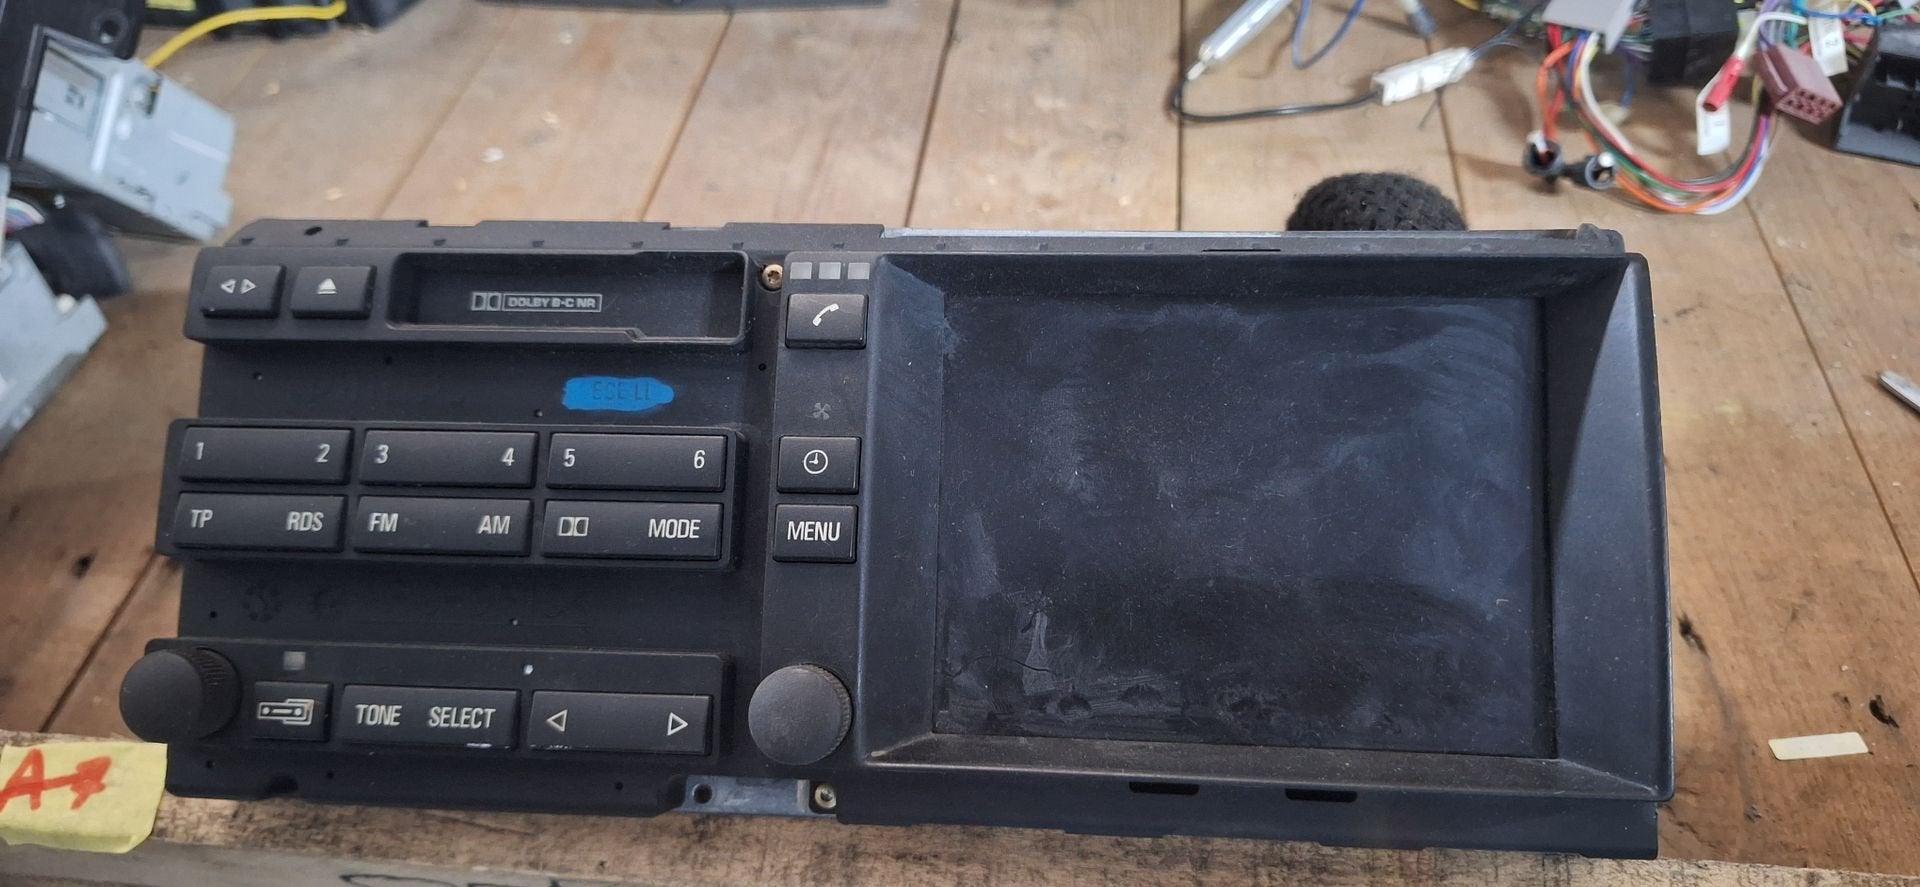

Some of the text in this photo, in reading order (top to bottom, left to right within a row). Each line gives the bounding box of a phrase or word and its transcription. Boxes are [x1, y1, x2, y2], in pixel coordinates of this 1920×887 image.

[508, 297, 551, 308] DOLBY
[576, 298, 596, 309] NR
[195, 442, 204, 460] 1
[315, 443, 330, 463] 2
[374, 444, 389, 464] 3
[501, 447, 515, 466] 4
[563, 448, 576, 468] 5
[693, 450, 706, 469] 6
[190, 509, 213, 528] TP
[286, 511, 324, 531] RDS
[368, 512, 398, 532] FM
[477, 515, 511, 534] AM
[648, 518, 701, 539] MODE
[787, 521, 841, 542] MENU
[355, 704, 402, 726] TONE
[428, 706, 496, 729] SELECT
